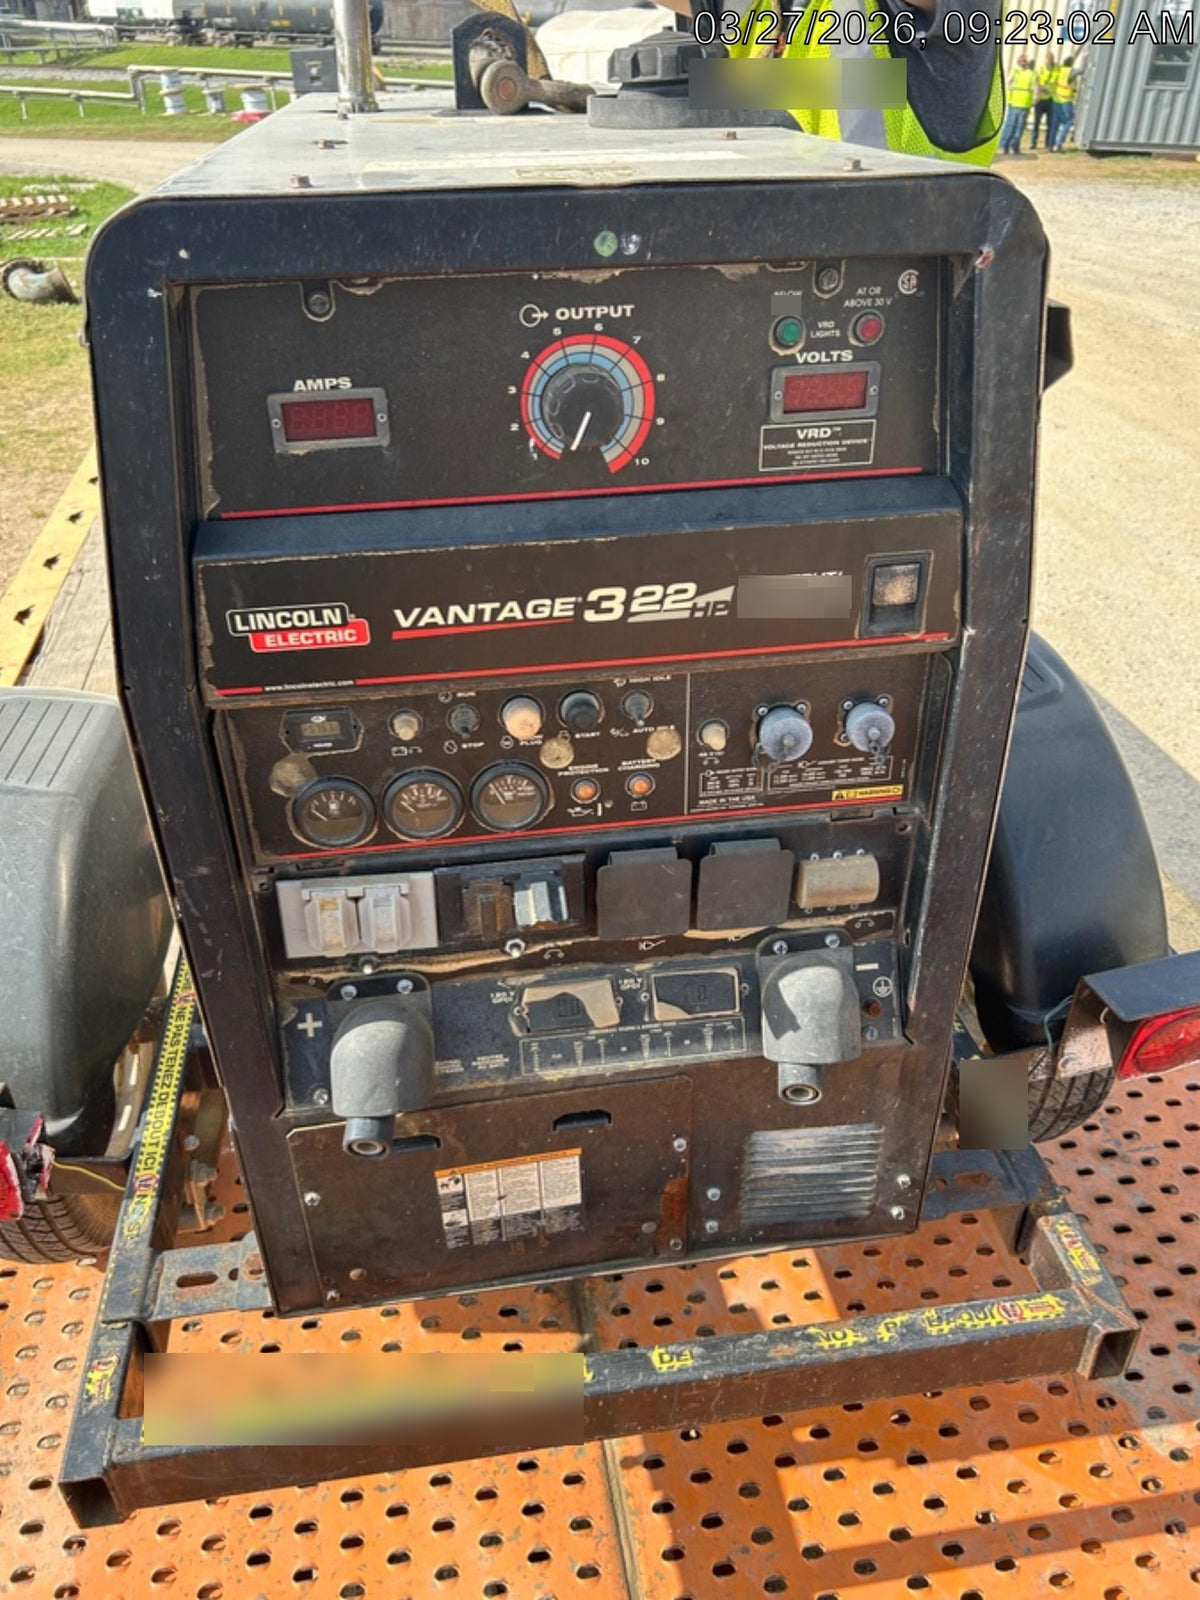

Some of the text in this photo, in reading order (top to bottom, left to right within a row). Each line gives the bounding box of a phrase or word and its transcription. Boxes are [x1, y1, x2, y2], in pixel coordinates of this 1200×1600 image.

[868, 285, 882, 296] OR
[843, 297, 873, 309] ABOVE
[555, 304, 635, 321] OUTPUT
[593, 322, 604, 333] 6
[817, 320, 835, 329] VRD
[810, 328, 841, 339] LIGHTS
[632, 335, 642, 345] 7
[520, 350, 531, 360] 4
[794, 350, 854, 364] VOLTS
[293, 376, 353, 392] AMPS
[507, 385, 518, 396] 3
[656, 415, 666, 426] 9
[509, 422, 520, 432] 2
[634, 456, 651, 467] 10
[393, 597, 576, 628] VANTAGE
[583, 581, 698, 623] 322
[234, 607, 343, 632] LINCOLN
[264, 629, 358, 648] ELECTRIC
[170, 1023, 184, 1048] PAS
[161, 1048, 180, 1090] TENEZ
[147, 1092, 170, 1148] DEBOUT
[143, 1151, 158, 1171] ICI
